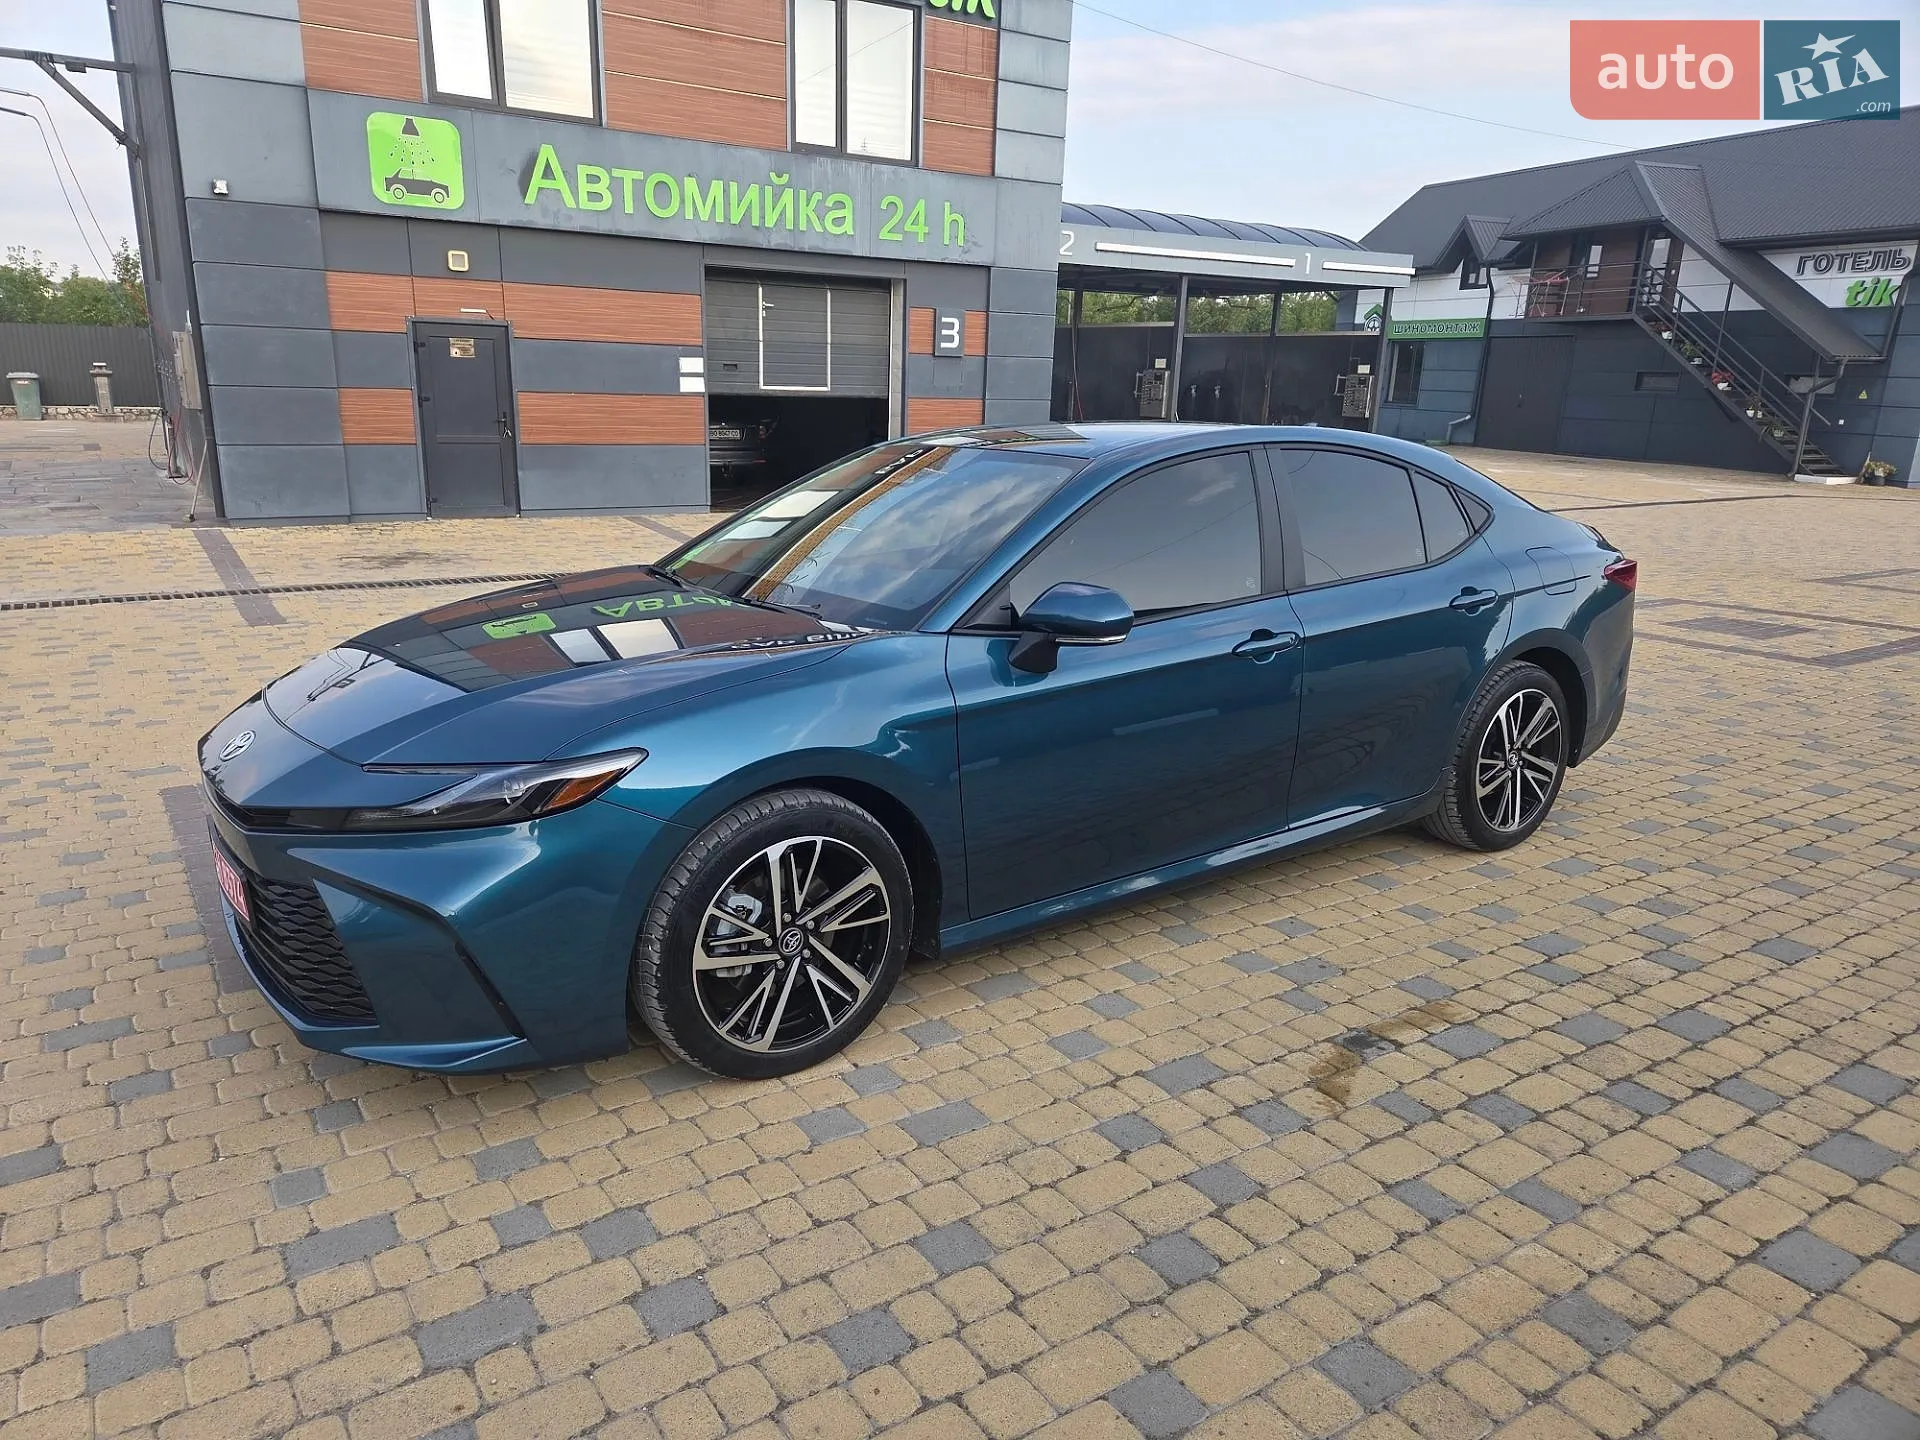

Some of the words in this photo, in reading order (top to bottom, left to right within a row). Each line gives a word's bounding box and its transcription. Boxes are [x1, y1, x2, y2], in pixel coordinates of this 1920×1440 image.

[524, 143, 855, 235] Автомийка
[878, 196, 929, 243] 24
[943, 201, 966, 248] h
[1059, 230, 1075, 256] 2
[1304, 252, 1312, 274] 1
[1795, 248, 1912, 276] ГОТЕЛЬ
[1845, 276, 1902, 307] tik
[940, 316, 960, 349] 3
